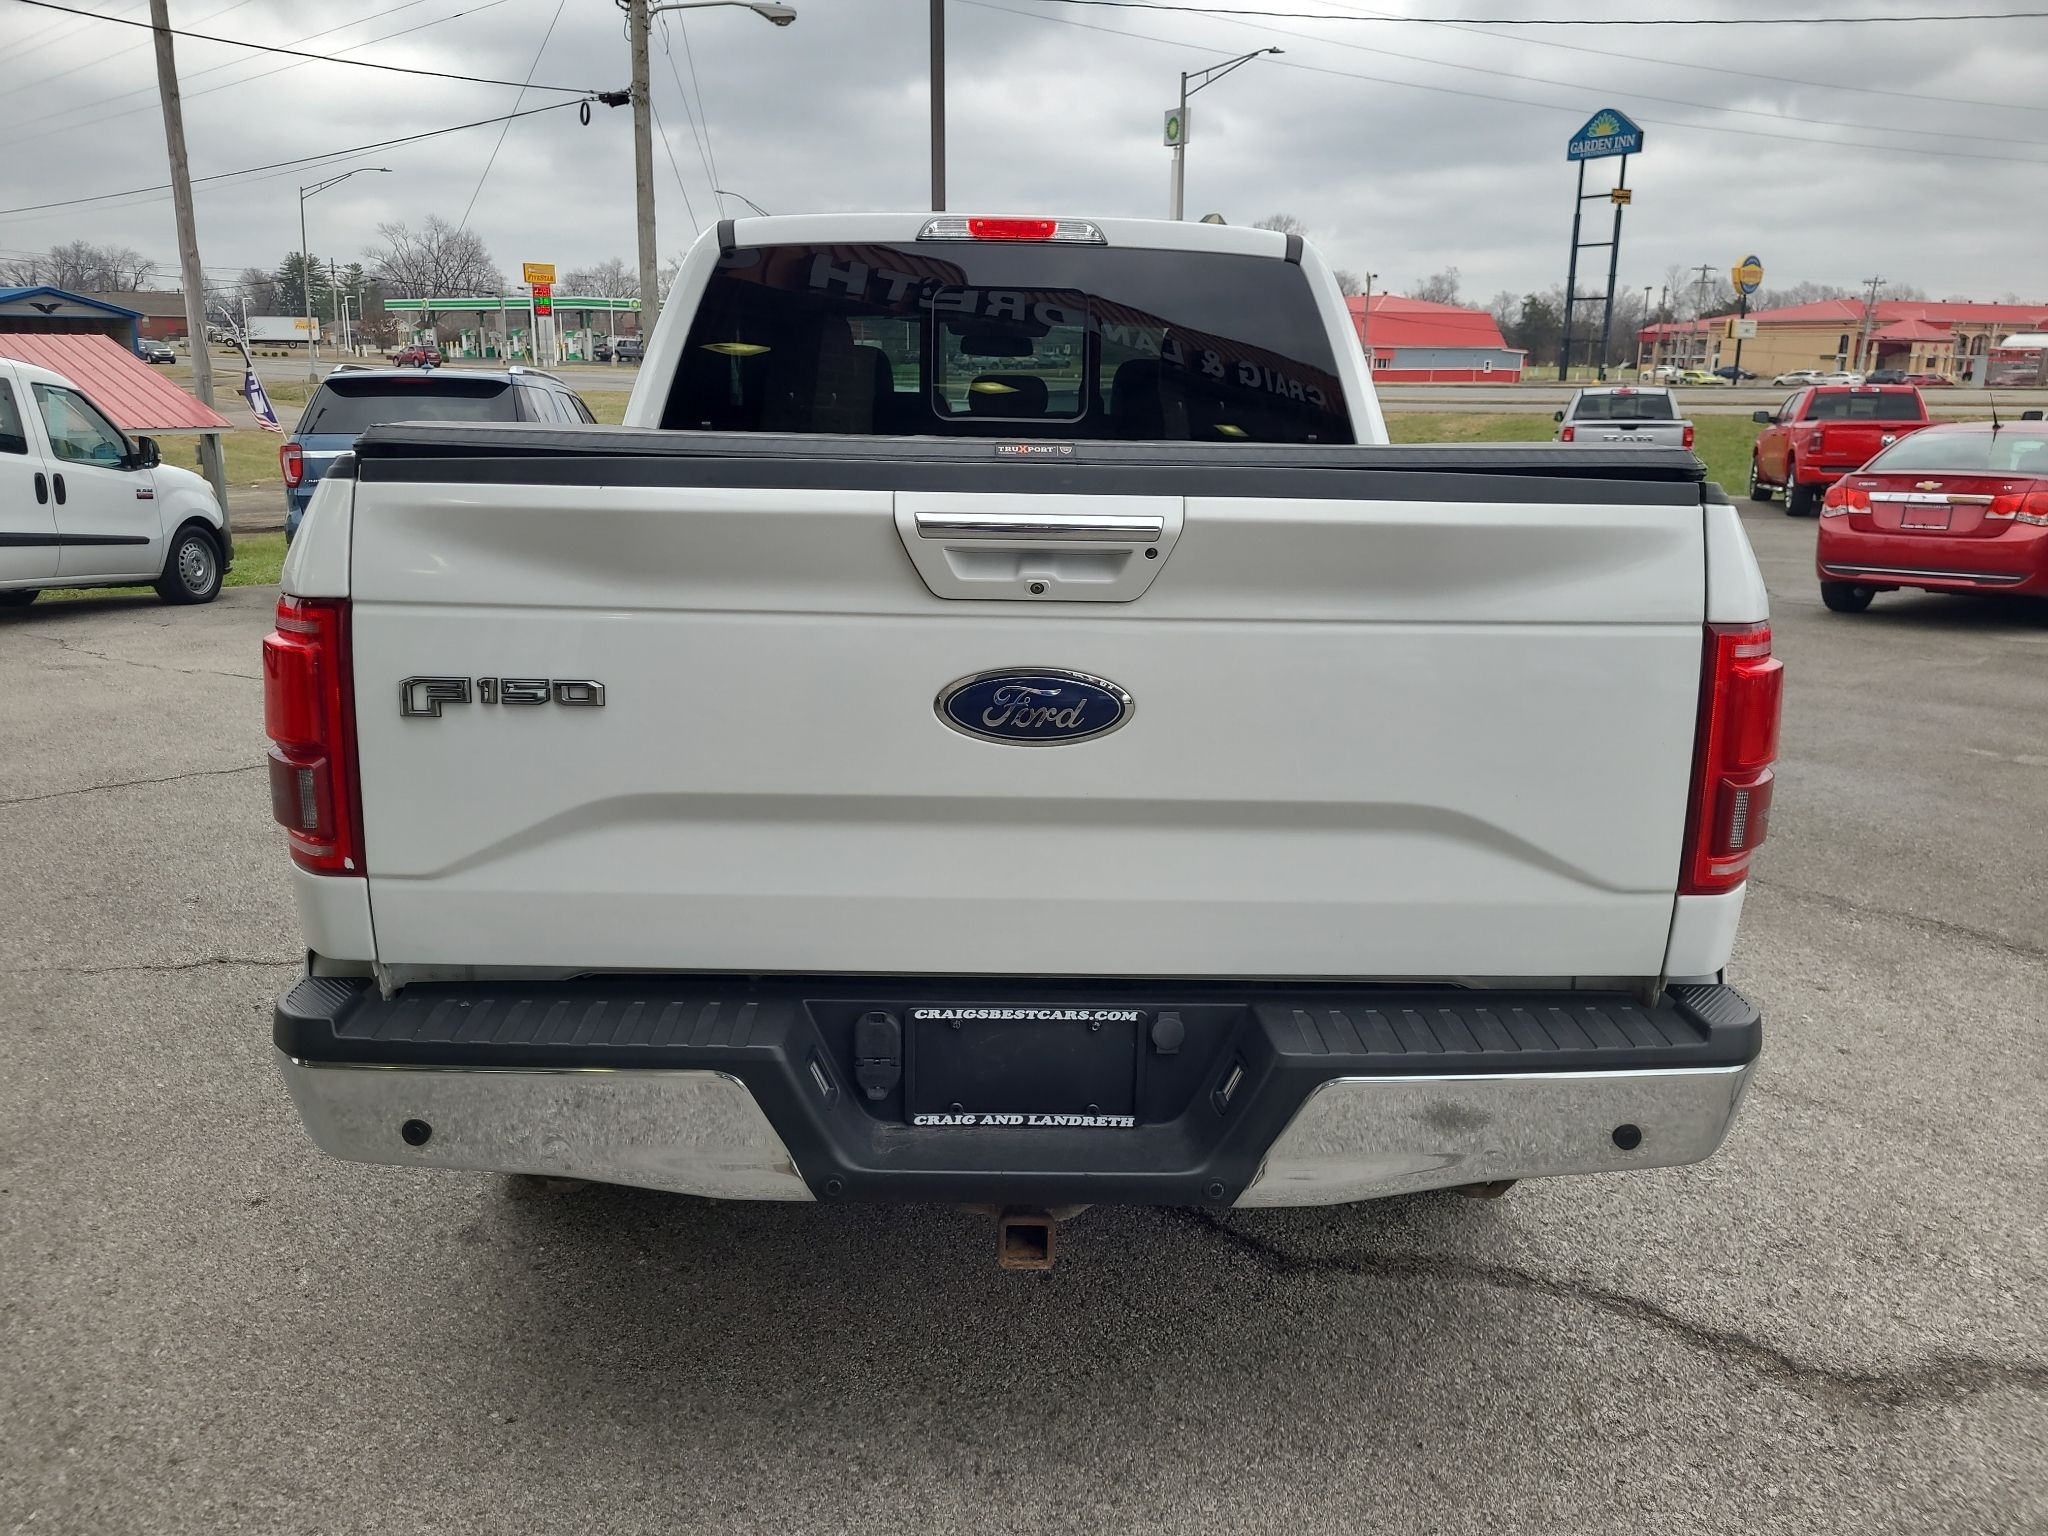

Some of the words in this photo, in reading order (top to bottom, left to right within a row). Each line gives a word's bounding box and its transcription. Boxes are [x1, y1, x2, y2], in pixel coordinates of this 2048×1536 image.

[1570, 137, 1613, 154] GARDEN
[1614, 134, 1636, 147] INN
[998, 444, 1055, 454] TRUXPORT
[982, 685, 1088, 728] Ford
[914, 1009, 1138, 1021] CRAIGSBESTCARS.COM
[914, 1115, 976, 1126] CRAIG
[980, 1115, 1024, 1125] AND
[1027, 1116, 1135, 1127] LANDRETH
